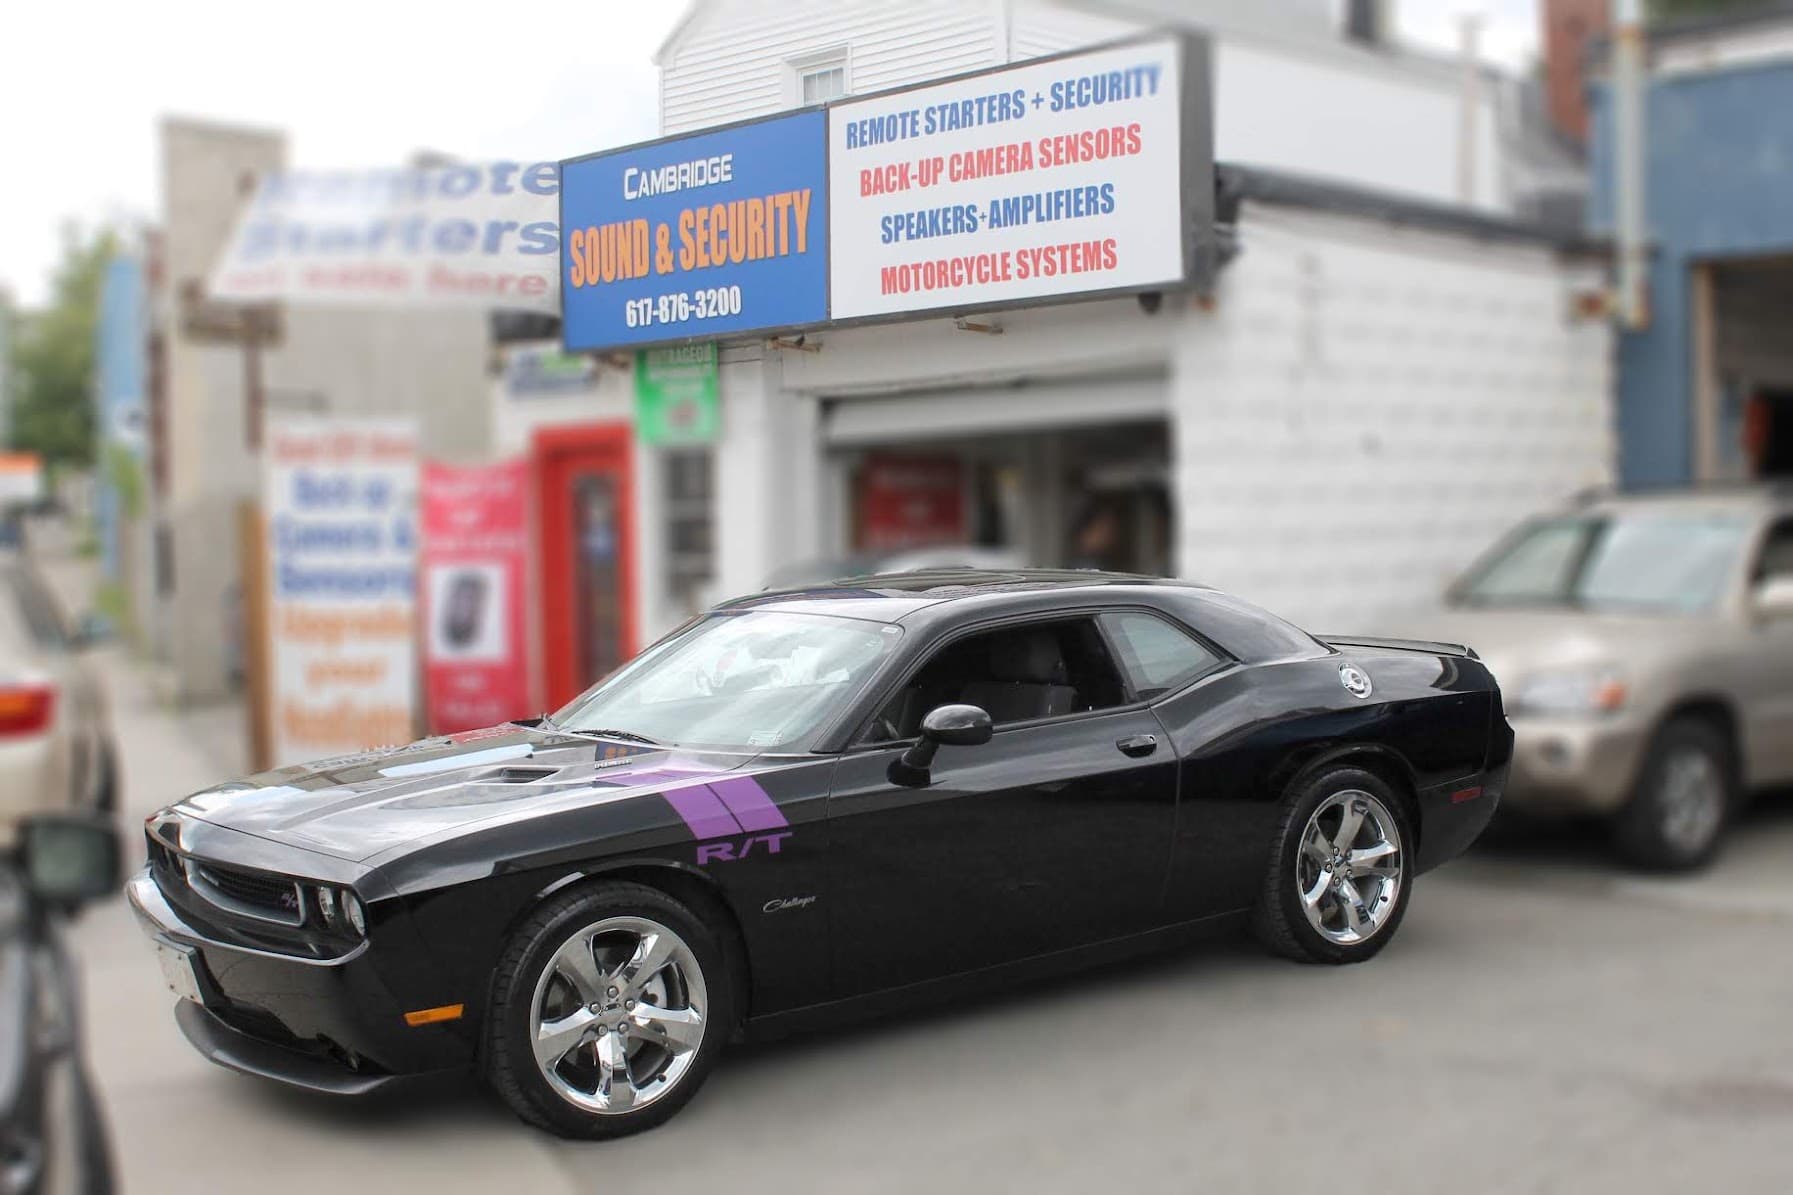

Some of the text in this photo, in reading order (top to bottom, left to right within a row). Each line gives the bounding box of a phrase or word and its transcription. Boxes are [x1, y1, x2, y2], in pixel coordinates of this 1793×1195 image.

[846, 63, 1163, 150] REMOTE STARTERS + SECURITY
[860, 123, 1142, 198] BACK-UP CAMERA SENSORS
[570, 189, 811, 288] SOUND & SECURITY
[881, 238, 1117, 295] MOTORCYCLE SYSTEMS
[625, 285, 742, 328] 617-876-3200
[696, 832, 793, 866] R/T
